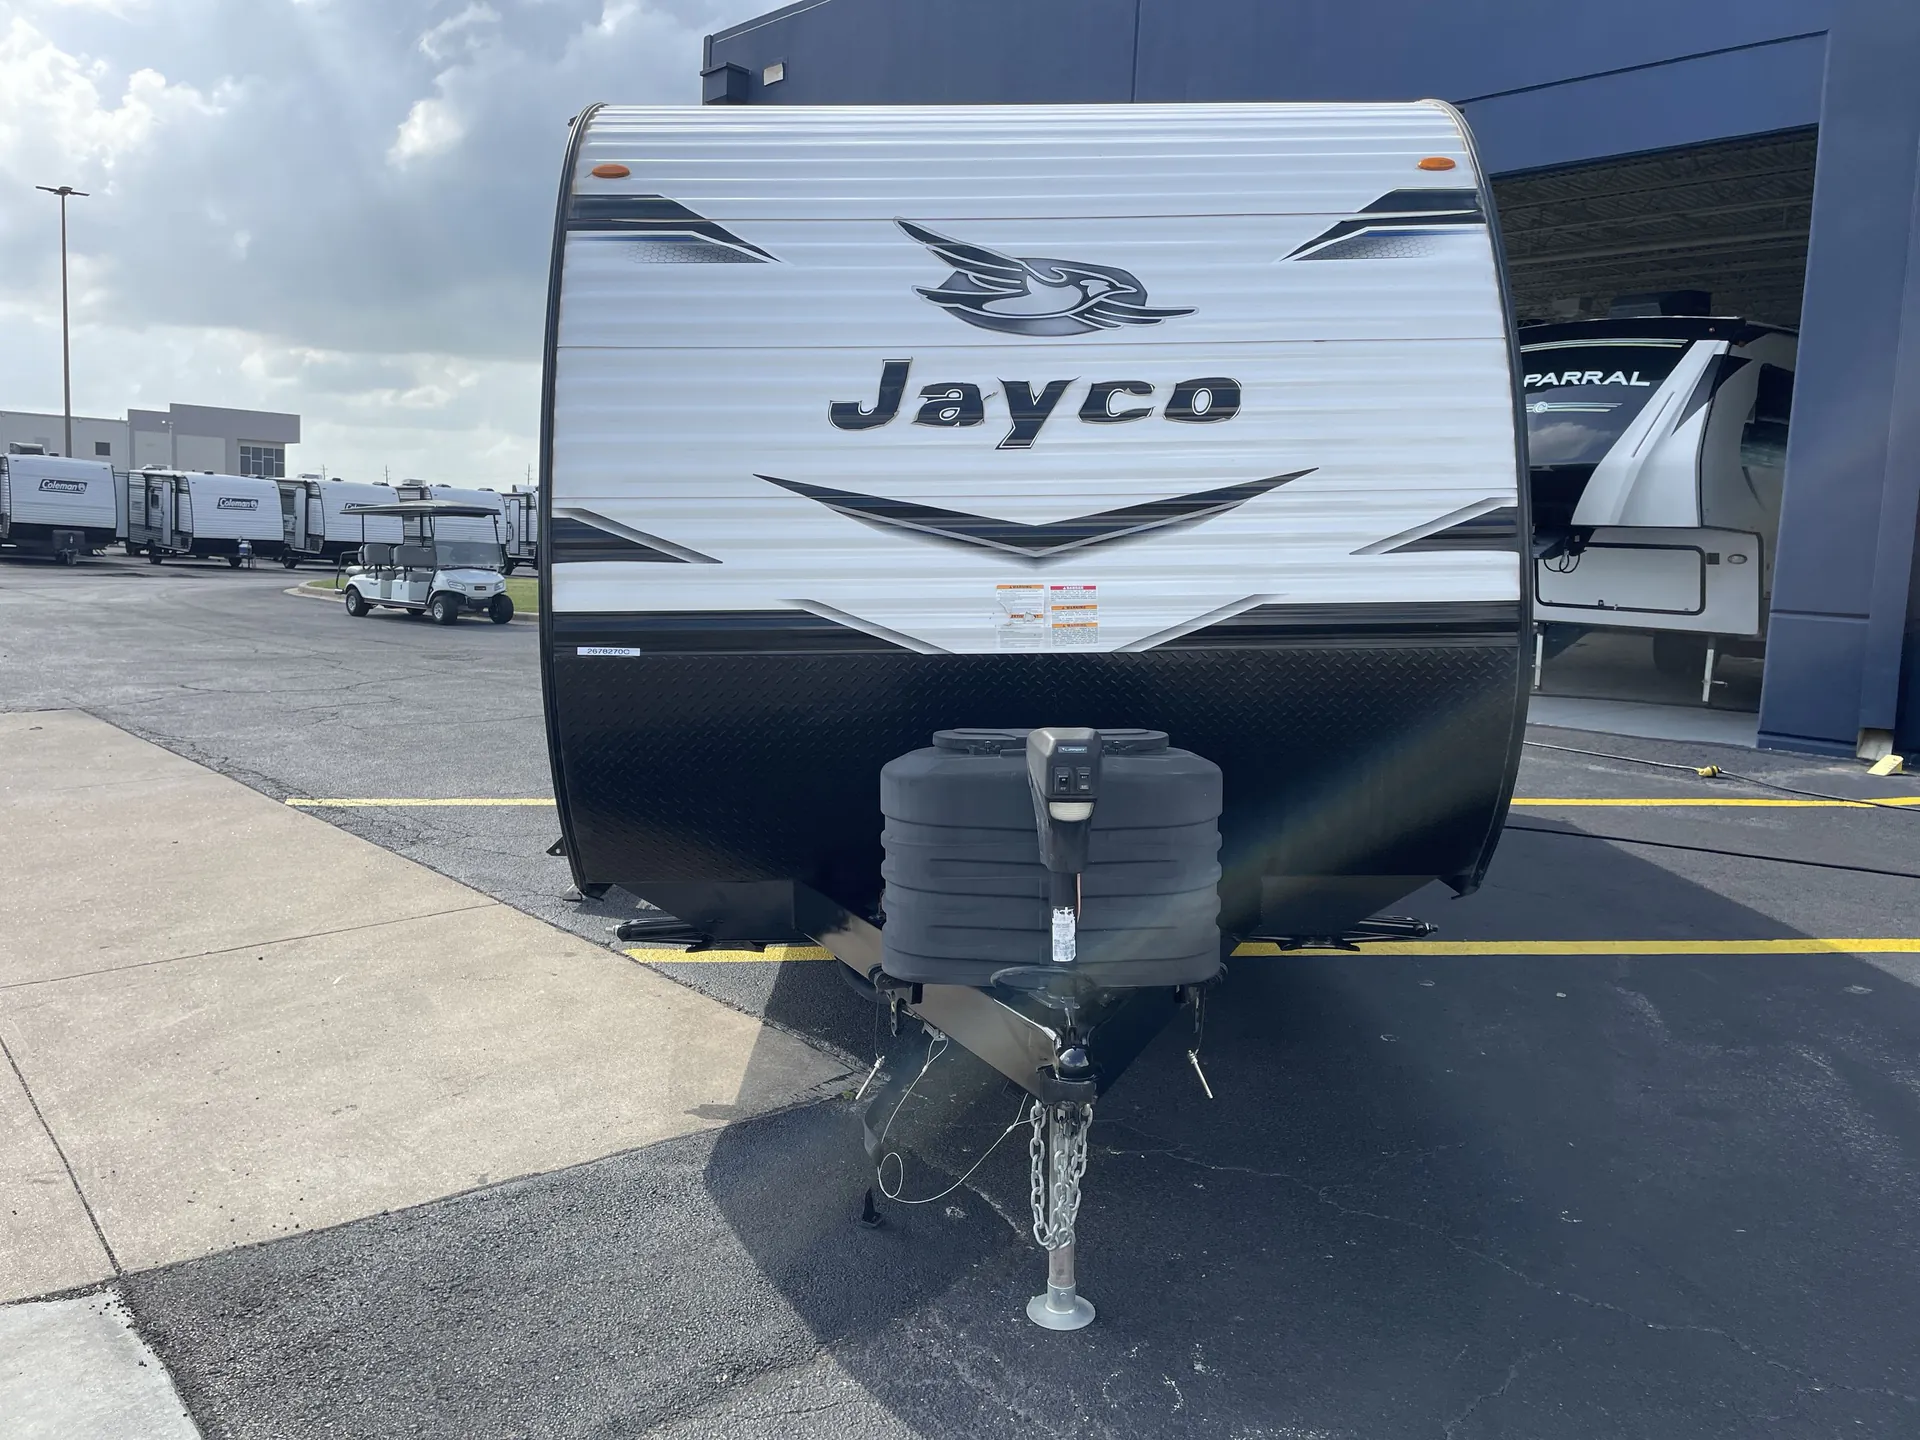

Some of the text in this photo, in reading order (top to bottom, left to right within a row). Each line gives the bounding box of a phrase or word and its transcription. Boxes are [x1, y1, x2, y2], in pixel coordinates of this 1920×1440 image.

[828, 356, 1242, 450] Jayco
[41, 479, 78, 491] Coleman
[219, 498, 251, 508] Coleman
